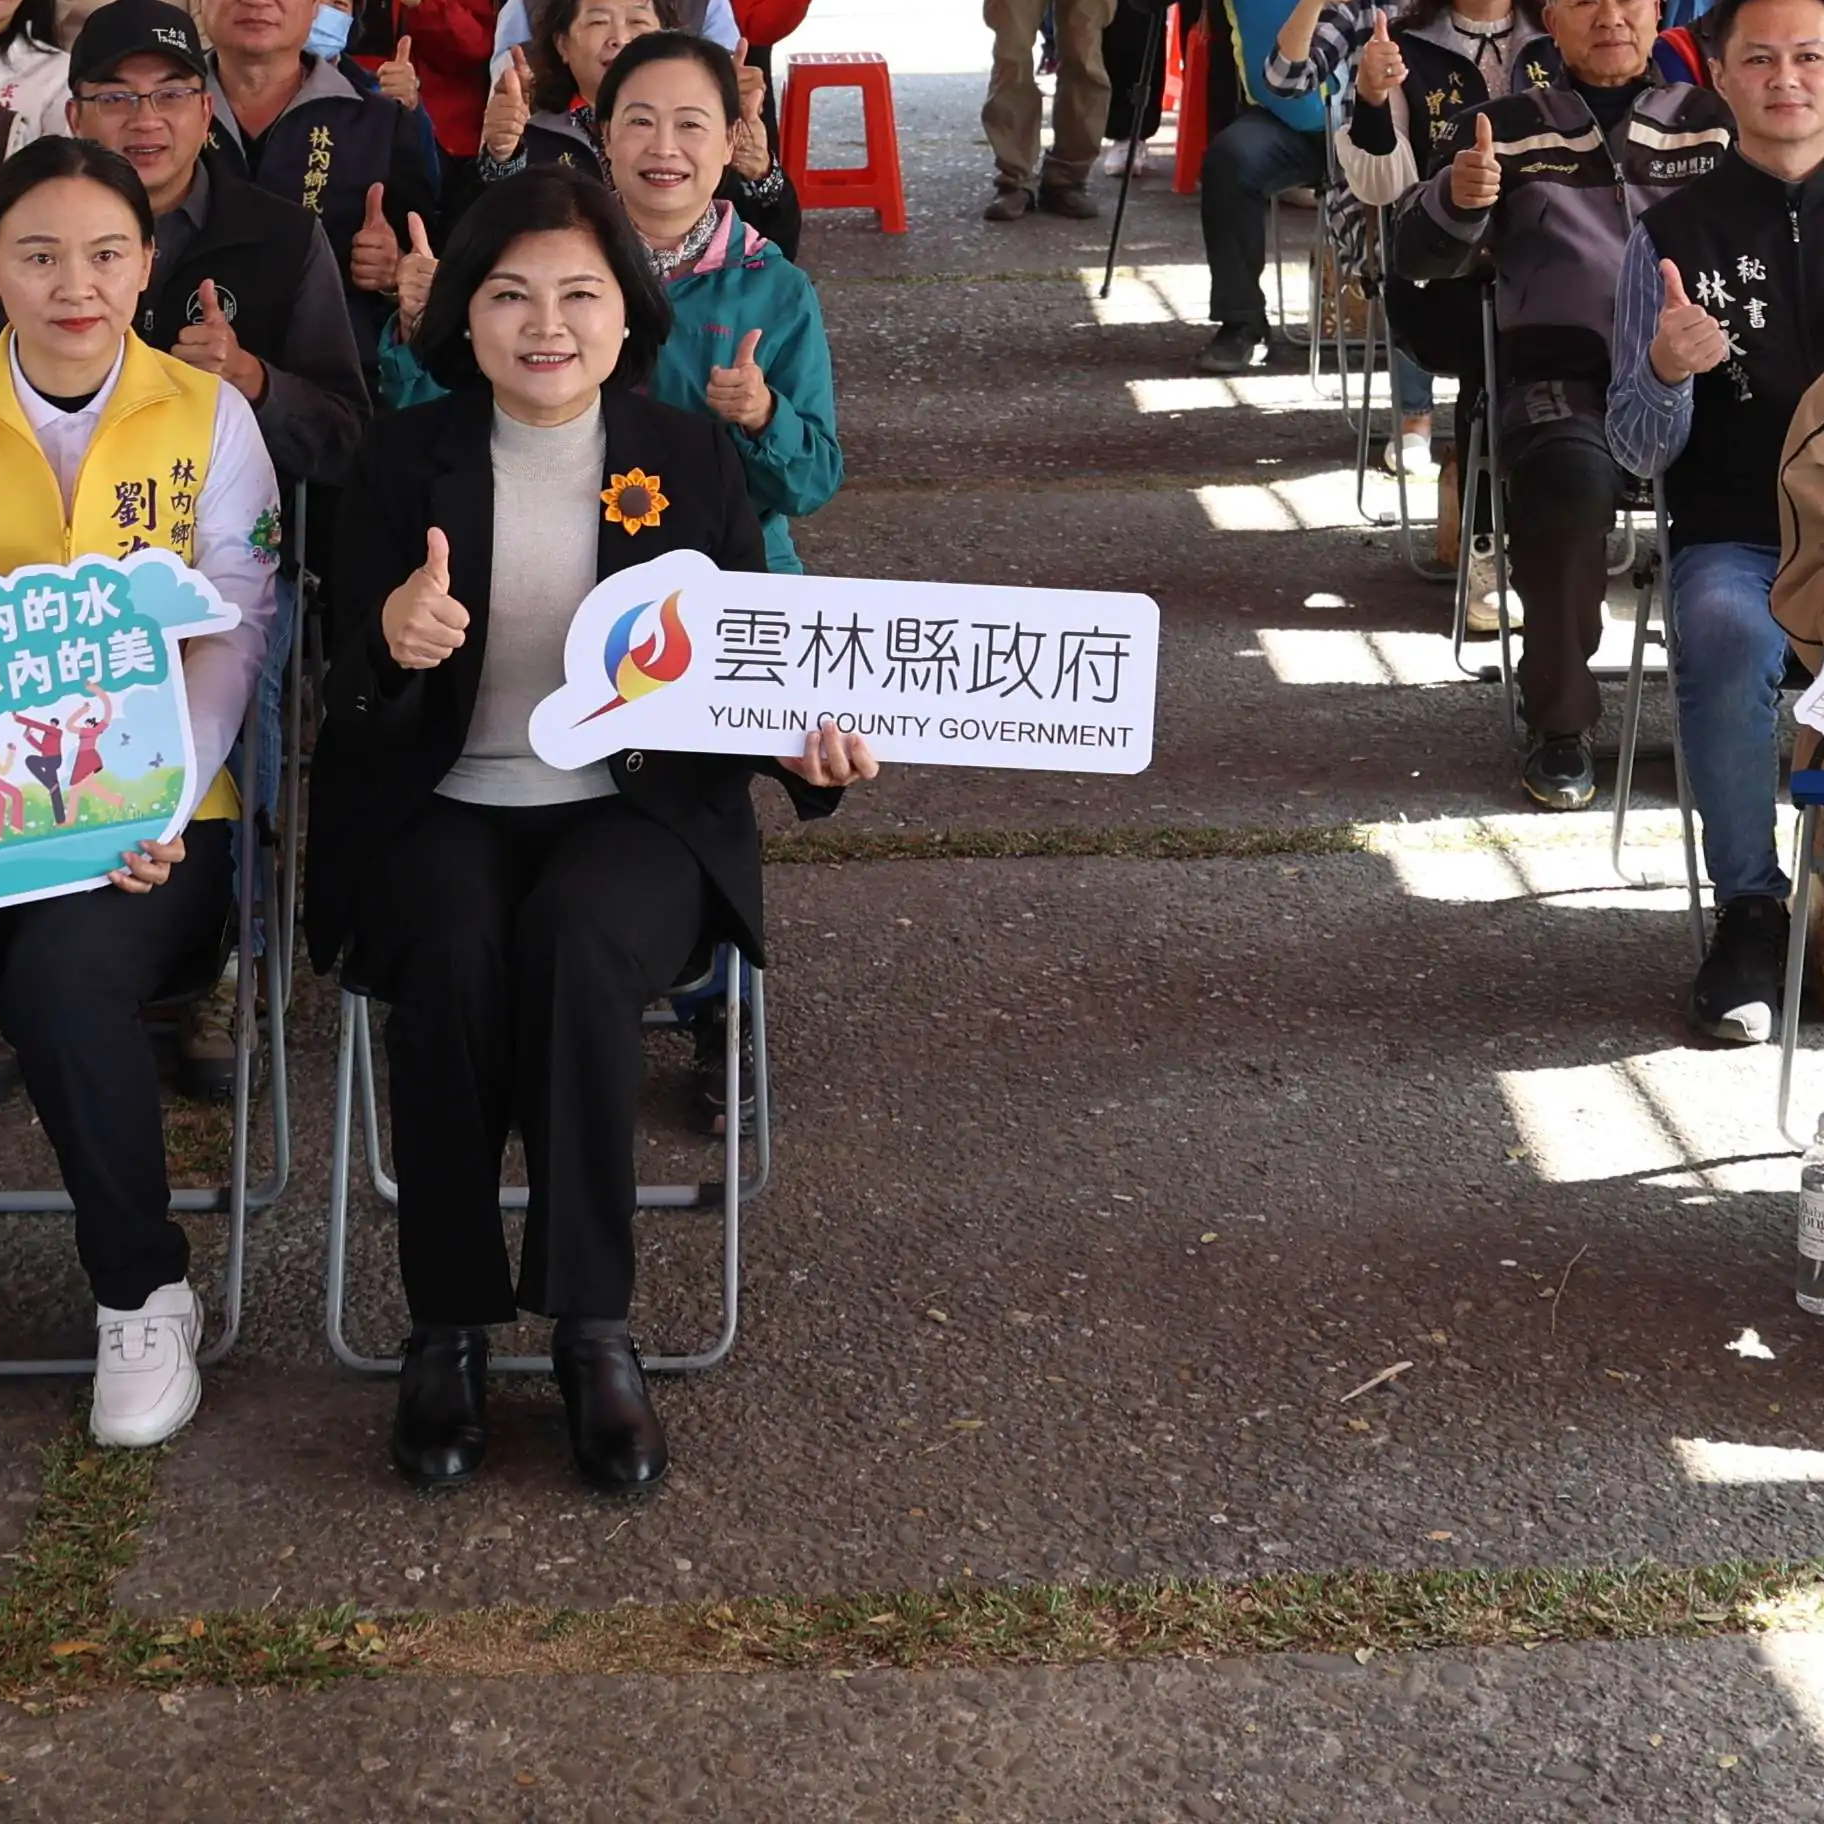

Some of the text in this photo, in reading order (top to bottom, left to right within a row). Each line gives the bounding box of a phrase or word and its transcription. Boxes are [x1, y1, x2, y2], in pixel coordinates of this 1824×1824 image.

[1736, 255, 1768, 328] 秘書
[169, 458, 198, 558] 林內鄉
[714, 608, 1132, 704] 雲林縣政府
[709, 706, 1134, 748] YUNLIN COUNTY GOVERNMENT
